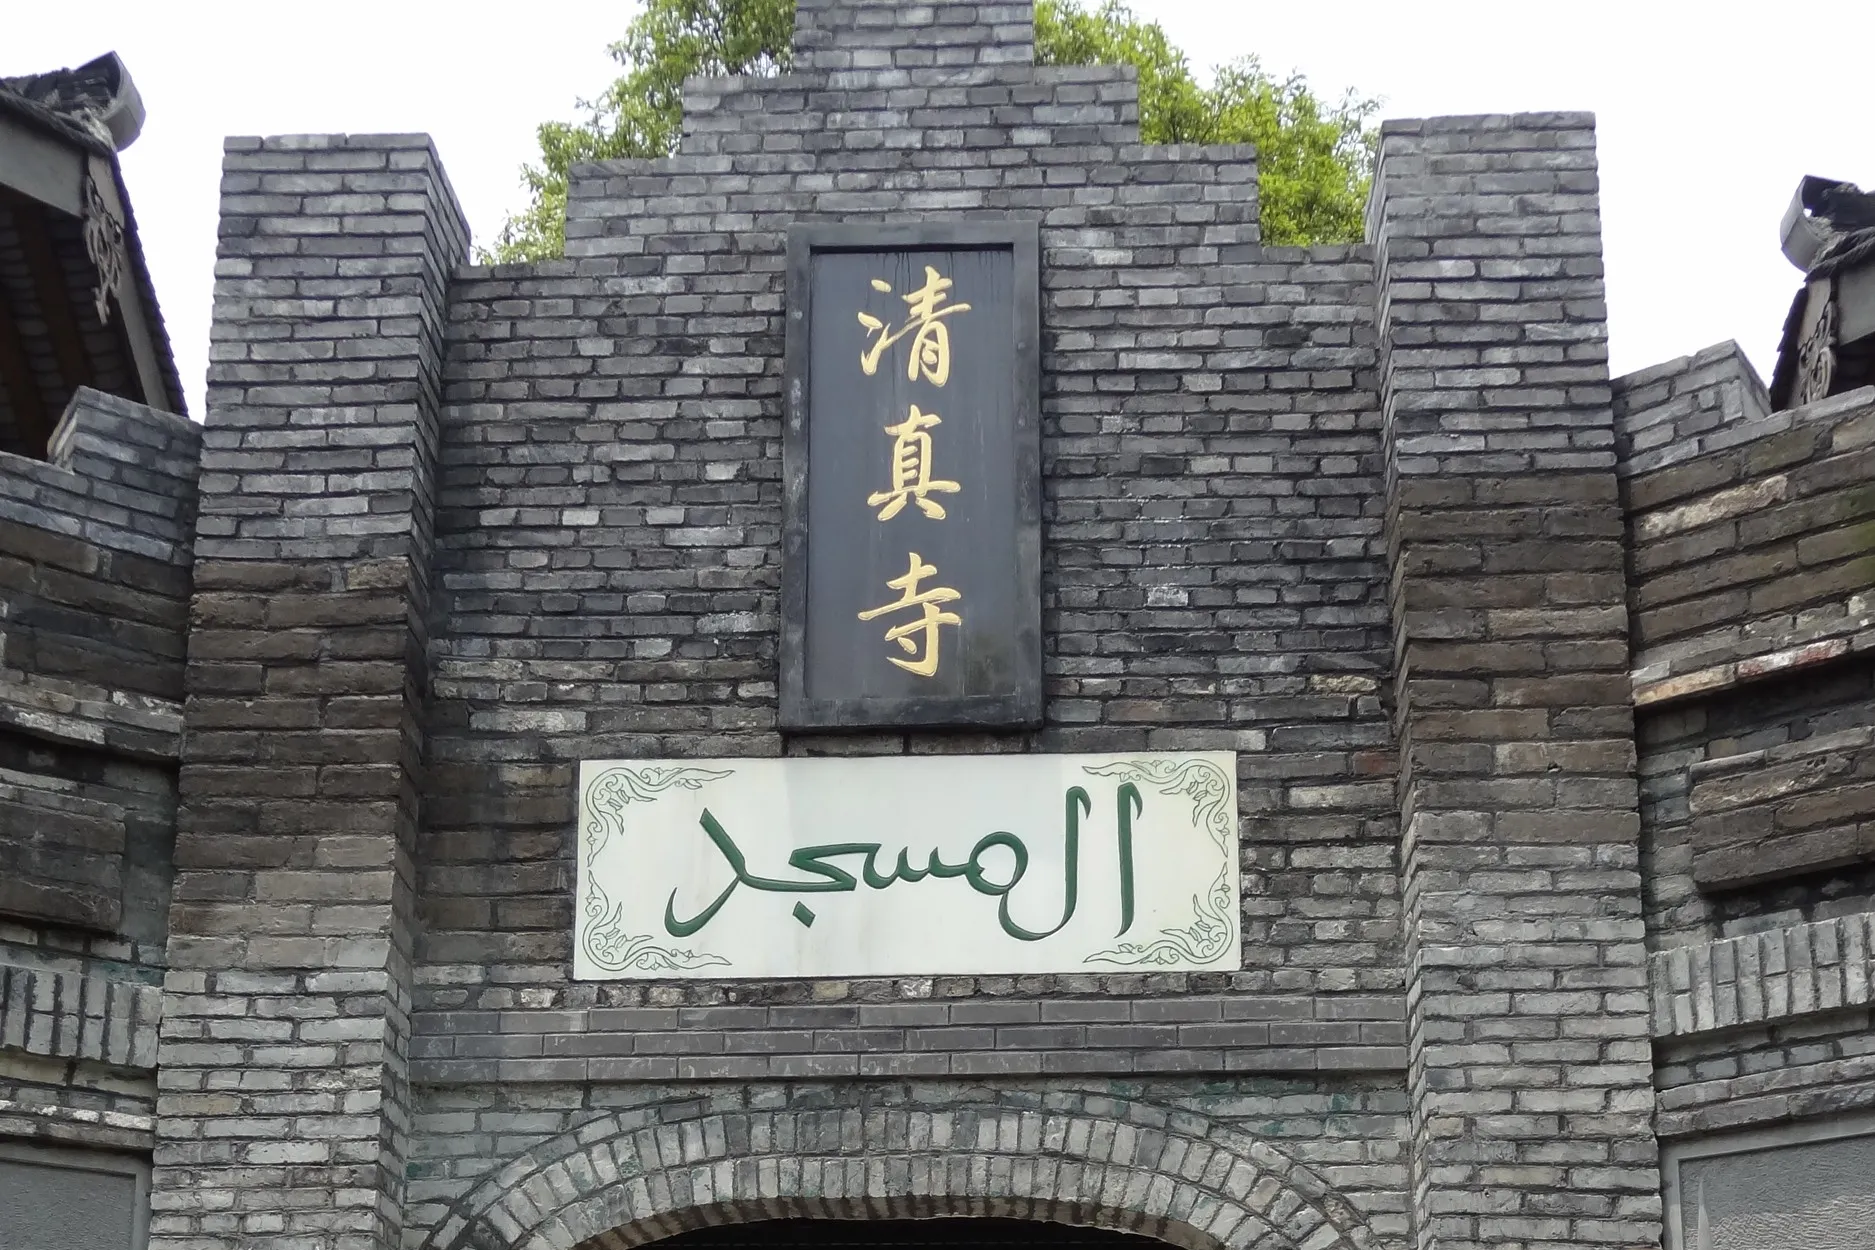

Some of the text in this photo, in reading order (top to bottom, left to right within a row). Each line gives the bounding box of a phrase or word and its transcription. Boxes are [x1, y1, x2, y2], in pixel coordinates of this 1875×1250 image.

[858, 265, 972, 678] 清真寺
[663, 782, 1144, 942] المسجد
